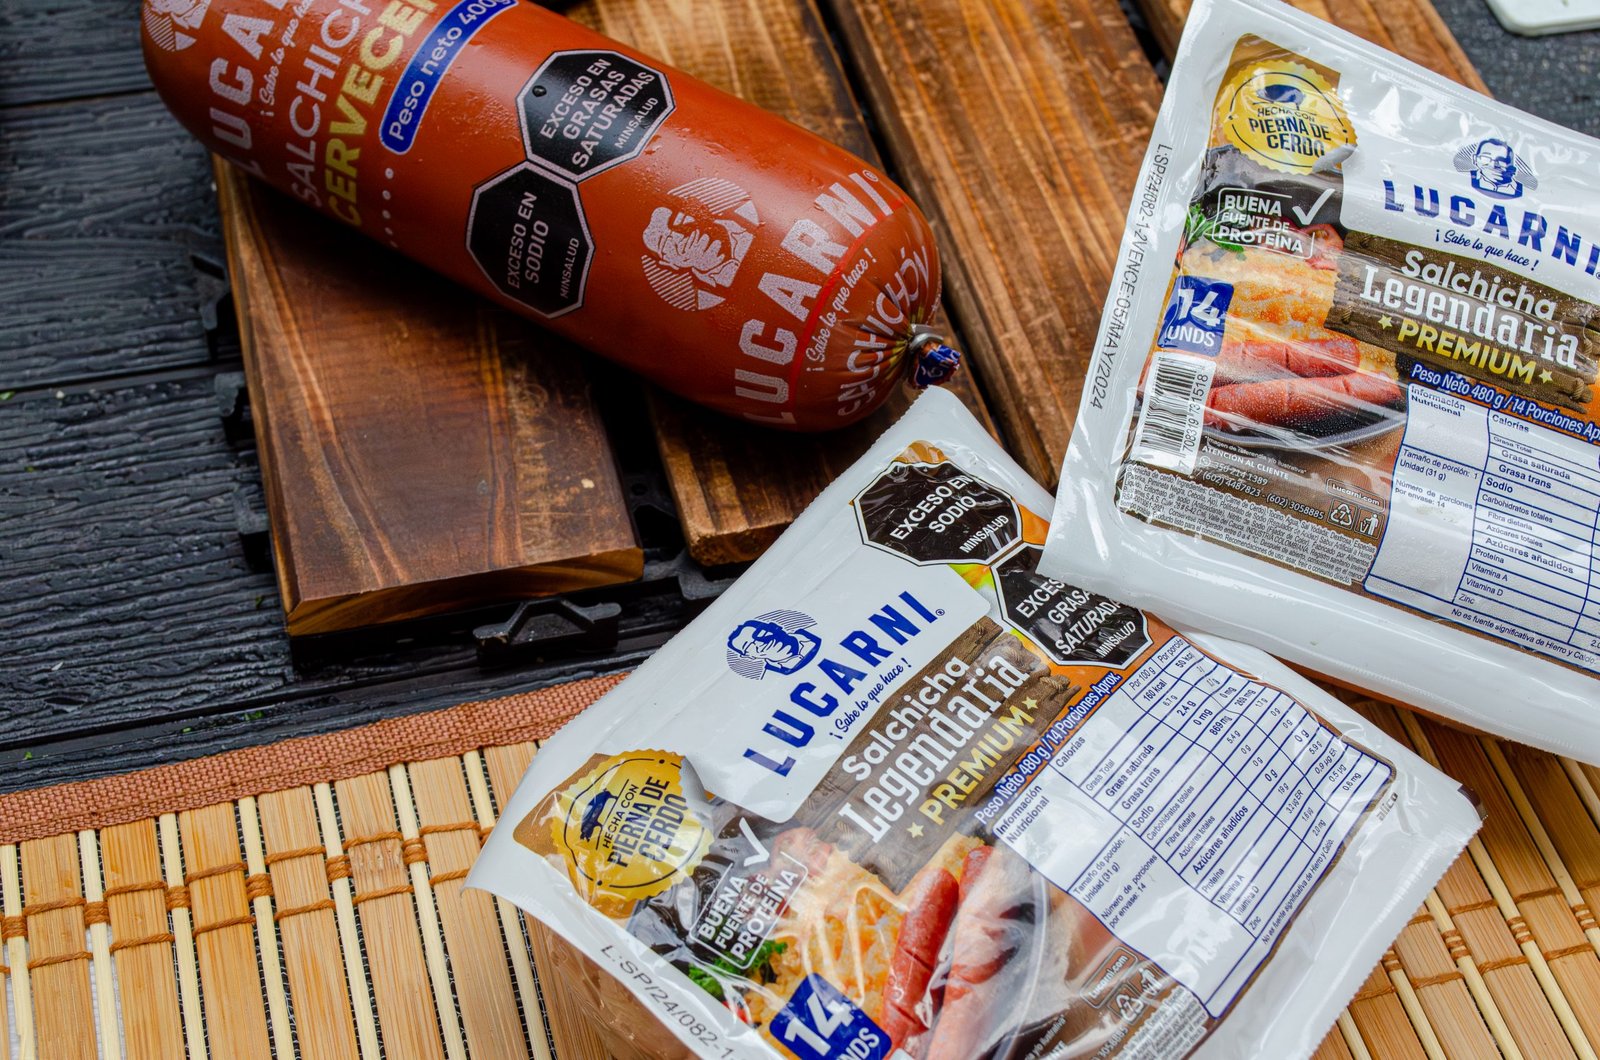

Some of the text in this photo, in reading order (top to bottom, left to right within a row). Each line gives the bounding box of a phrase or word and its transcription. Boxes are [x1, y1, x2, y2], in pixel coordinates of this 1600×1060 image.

[209, 0, 288, 177] LUCA
[286, 0, 371, 207] SALCHIC
[389, 80, 426, 141] Peso
[421, 27, 463, 76] neto
[540, 58, 612, 139] EXCESO EN
[562, 70, 626, 140] GRASAS
[572, 71, 655, 168] SATURADAS
[614, 97, 659, 149] MINSALUD
[1248, 117, 1332, 142] PIERNA DE
[1267, 133, 1325, 158] CERDO
[1221, 212, 1291, 233] FUENTE DE
[1224, 195, 1282, 217] BUENA
[508, 191, 538, 289] EXCESO EN
[525, 220, 549, 284] SODIO
[1218, 227, 1304, 254] PROTEÍNA
[1443, 229, 1530, 267] Sabe lo que hace
[560, 238, 580, 299] MINSALUD
[1401, 250, 1557, 321] Salchicha
[806, 259, 869, 363] Sabe lo que hace
[1178, 288, 1221, 328] 14
[1360, 264, 1580, 370] Legendaria
[1168, 325, 1216, 348] UNDS
[1397, 319, 1538, 384] PREMIUM
[1411, 385, 1466, 411] Información
[1411, 364, 1583, 434] Peso Neto 480 Porciones
[1411, 395, 1462, 418] Nutricional
[1492, 413, 1530, 433] Calorías
[1202, 445, 1290, 480] ATENCIÓN AL CLIENTE
[1399, 459, 1425, 475] Unidad
[1402, 449, 1432, 466] Tamaño
[1432, 457, 1442, 468] de
[1498, 464, 1552, 490] Grasa trans
[1501, 449, 1571, 480] Grasa saturada
[1202, 470, 1325, 520] (602) 4487823 (602) 3058885
[1439, 493, 1473, 510] porciones
[1485, 477, 1514, 493] Sodio
[890, 474, 974, 541] EXCESO EN
[929, 494, 977, 534] SODIO
[1481, 494, 1529, 518] Carbohidratos
[959, 515, 1010, 553] MINSALUD
[1471, 563, 1501, 581] Vitamina
[1475, 548, 1505, 565] Proteína
[1485, 537, 1574, 575] Azúcares añadidos
[1015, 578, 1066, 619] EXCES
[1459, 593, 1476, 606] Zinc
[1466, 578, 1496, 596] Vitamina
[1095, 621, 1136, 658] MINSALUD
[1451, 608, 1568, 655] No fuente significativa Hierro
[1139, 670, 1152, 681] 100
[835, 663, 904, 733] Sabe lo que hace
[842, 655, 969, 781] Salchicha
[838, 655, 1030, 843] Legendaria
[918, 704, 1039, 825] PREMIUM
[974, 673, 1122, 825] Peso Neto 480 Porciones Aprox.
[1056, 735, 1086, 768] Calorías
[1105, 744, 1155, 798] Grasa saturada
[1121, 766, 1162, 811] Grasa trans
[602, 784, 639, 850] HECHA CON
[607, 776, 670, 868] PIERNA DE
[638, 794, 688, 863] CERDO
[995, 784, 1043, 836] Información
[1006, 795, 1050, 844] Nutricional
[1131, 804, 1155, 829] Sodio
[1192, 805, 1249, 875] Azúcares añadidos
[1073, 867, 1099, 895] Tamaño
[1082, 878, 1104, 904] Unidad
[1100, 854, 1158, 921] Número de porciones
[1201, 868, 1225, 893] Proteína
[1217, 881, 1240, 905] Vitamina
[700, 875, 749, 941] BUENA
[715, 873, 769, 950] FUENTE DE
[730, 870, 799, 961] PROTEÍNA
[1108, 914, 1121, 930] por
[1248, 915, 1262, 931] Zinc
[784, 992, 855, 1057] 14
[836, 1027, 880, 1060] NDS
